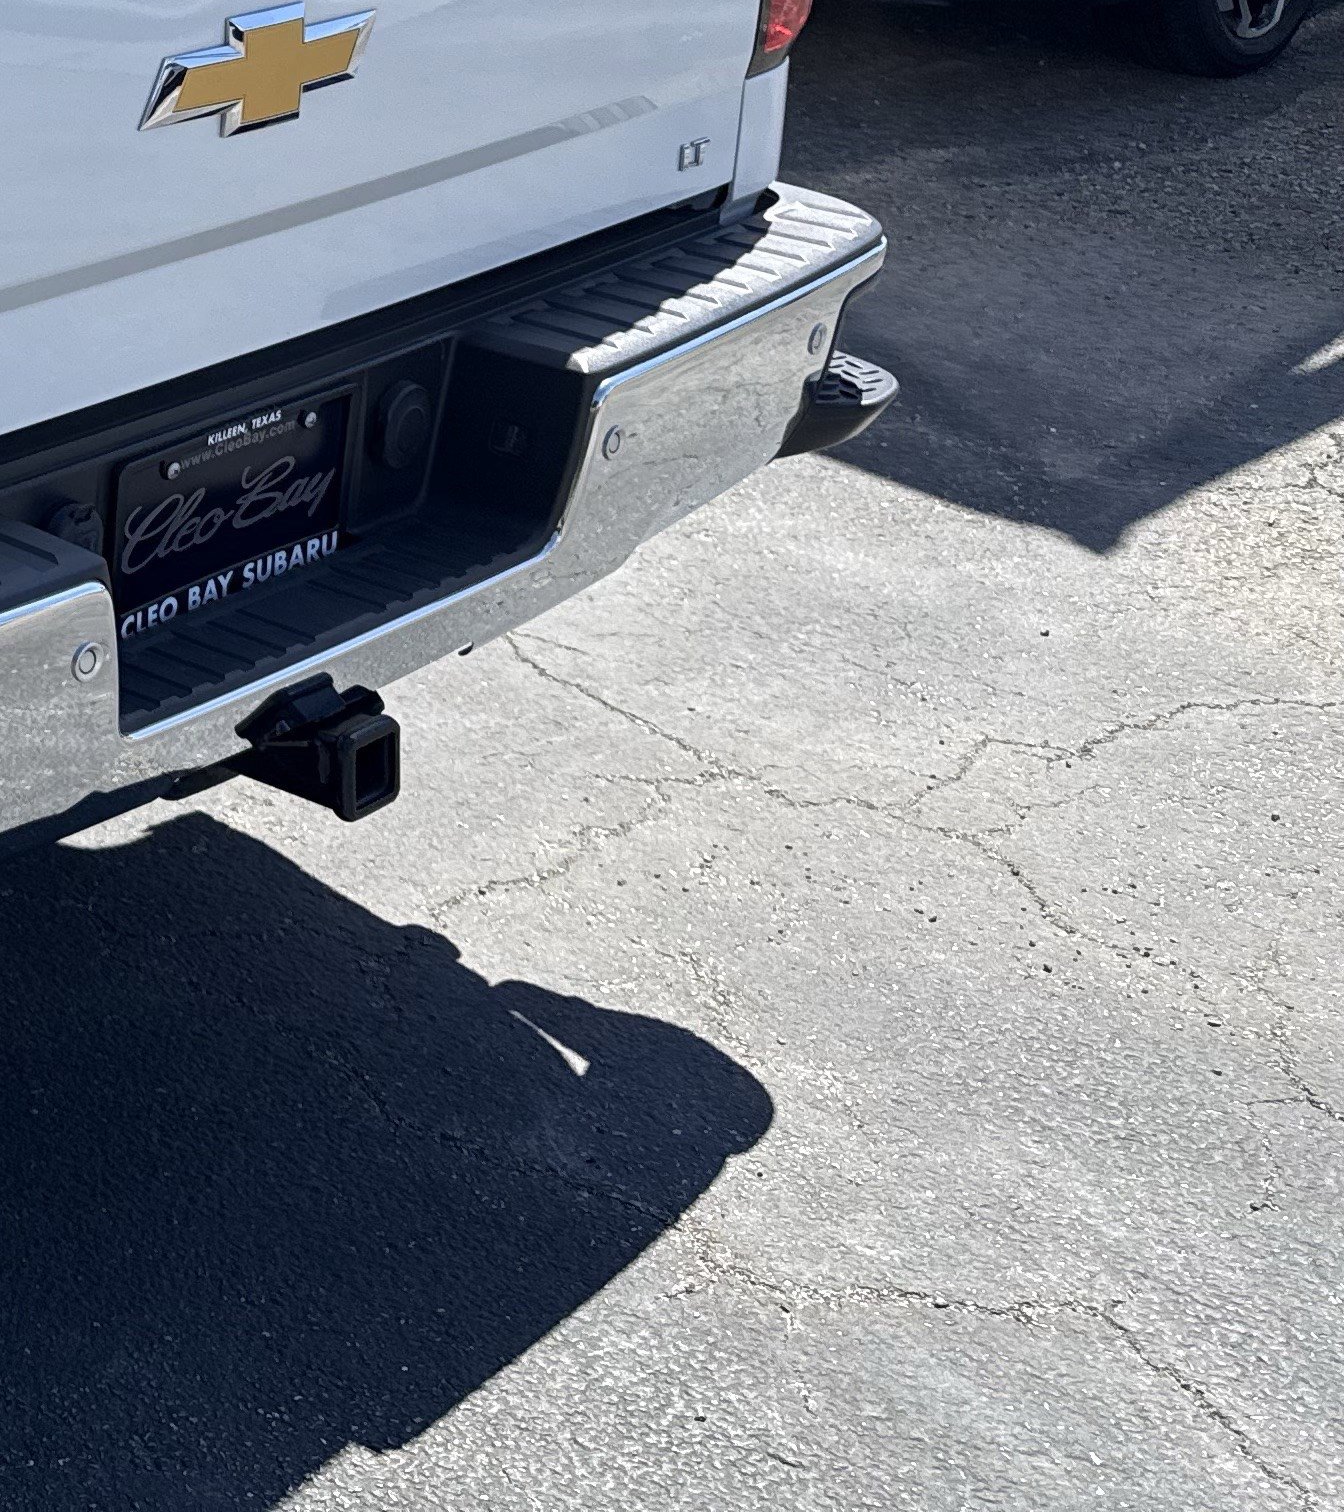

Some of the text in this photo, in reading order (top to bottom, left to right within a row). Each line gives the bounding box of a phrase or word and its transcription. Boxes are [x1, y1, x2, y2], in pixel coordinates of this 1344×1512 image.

[678, 136, 711, 172] LT
[207, 410, 282, 446] KILLEEN, TEXAS
[121, 456, 336, 574] Cleo Bay
[121, 530, 338, 639] CLEO BAY SUBARU
